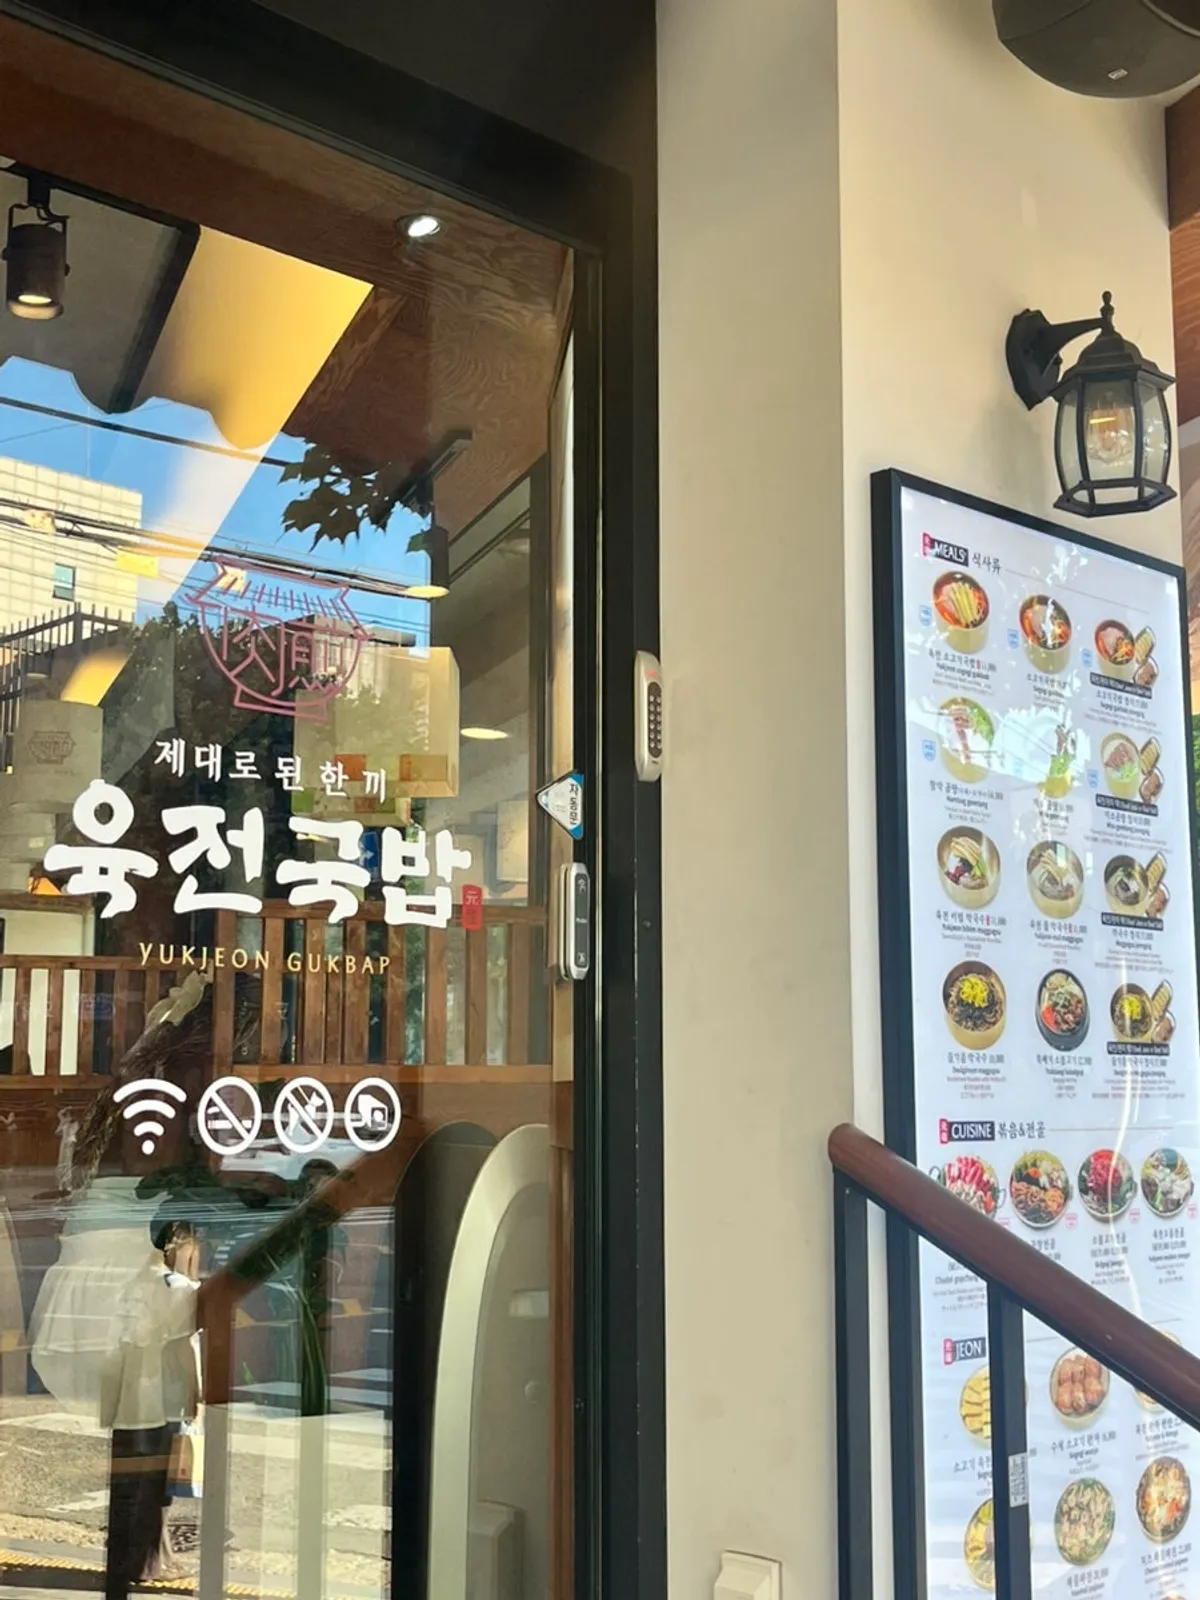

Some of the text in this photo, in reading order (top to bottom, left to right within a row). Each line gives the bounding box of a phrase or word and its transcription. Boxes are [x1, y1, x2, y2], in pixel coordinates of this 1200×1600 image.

[934, 541, 967, 564] MEALS
[972, 551, 1002, 575] 식사류
[154, 737, 387, 804] 제대로 된 한 끼
[569, 783, 579, 825] 자동문
[42, 778, 472, 929] 육전국밥
[139, 942, 392, 975] YUKJEON GUKBAP
[951, 1122, 992, 1140] CUISINE
[997, 1120, 1046, 1140] 볶음&전골
[956, 1340, 983, 1360] JEON
